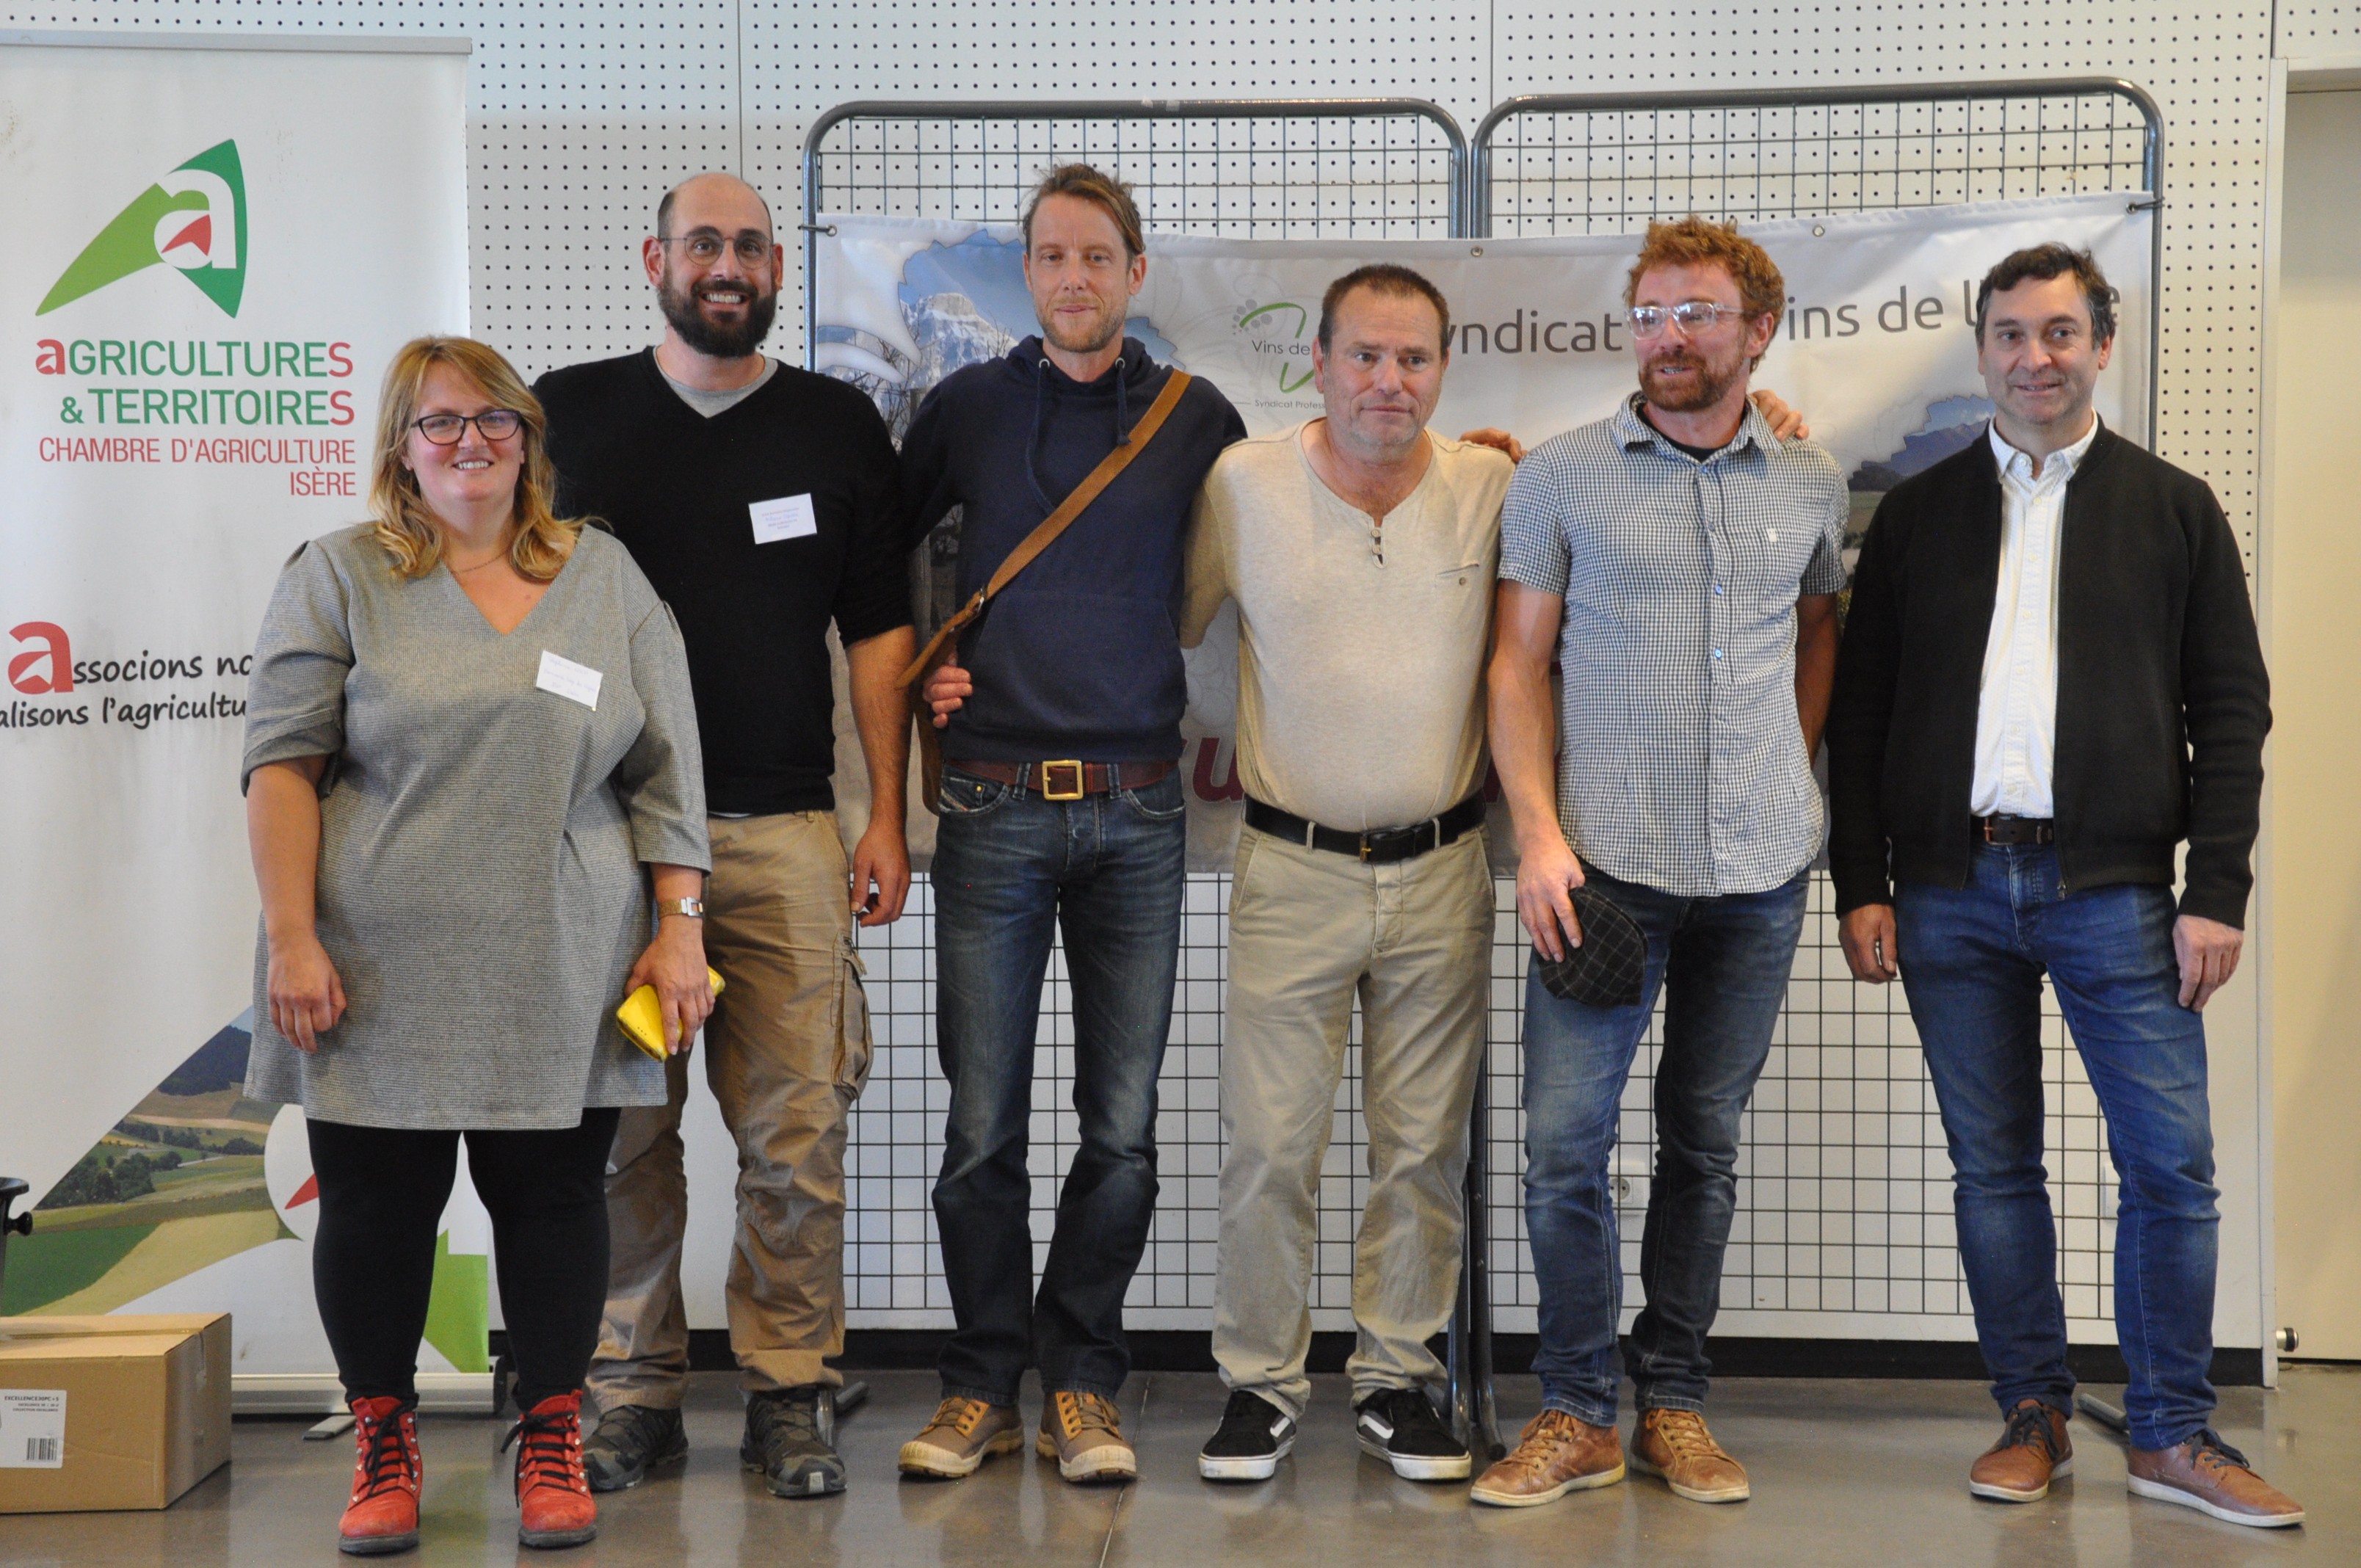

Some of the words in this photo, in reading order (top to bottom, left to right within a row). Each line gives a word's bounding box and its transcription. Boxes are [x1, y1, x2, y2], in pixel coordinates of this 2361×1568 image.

[1447, 308, 1623, 354] ndicat
[1787, 296, 1860, 341] ins
[1877, 285, 1944, 333] de
[1251, 340, 1283, 354] Vins
[1288, 343, 1310, 356] de
[60, 396, 85, 424] &
[87, 388, 355, 426] TERRITOIRES
[1295, 401, 1327, 410] Profess
[39, 437, 161, 463] CHAMBRE
[171, 438, 356, 464] D'AGRICULTURE
[290, 466, 357, 496] ISÈRE
[217, 654, 253, 676] no
[0, 700, 89, 728] alisons
[102, 691, 247, 730] l'agricultu
